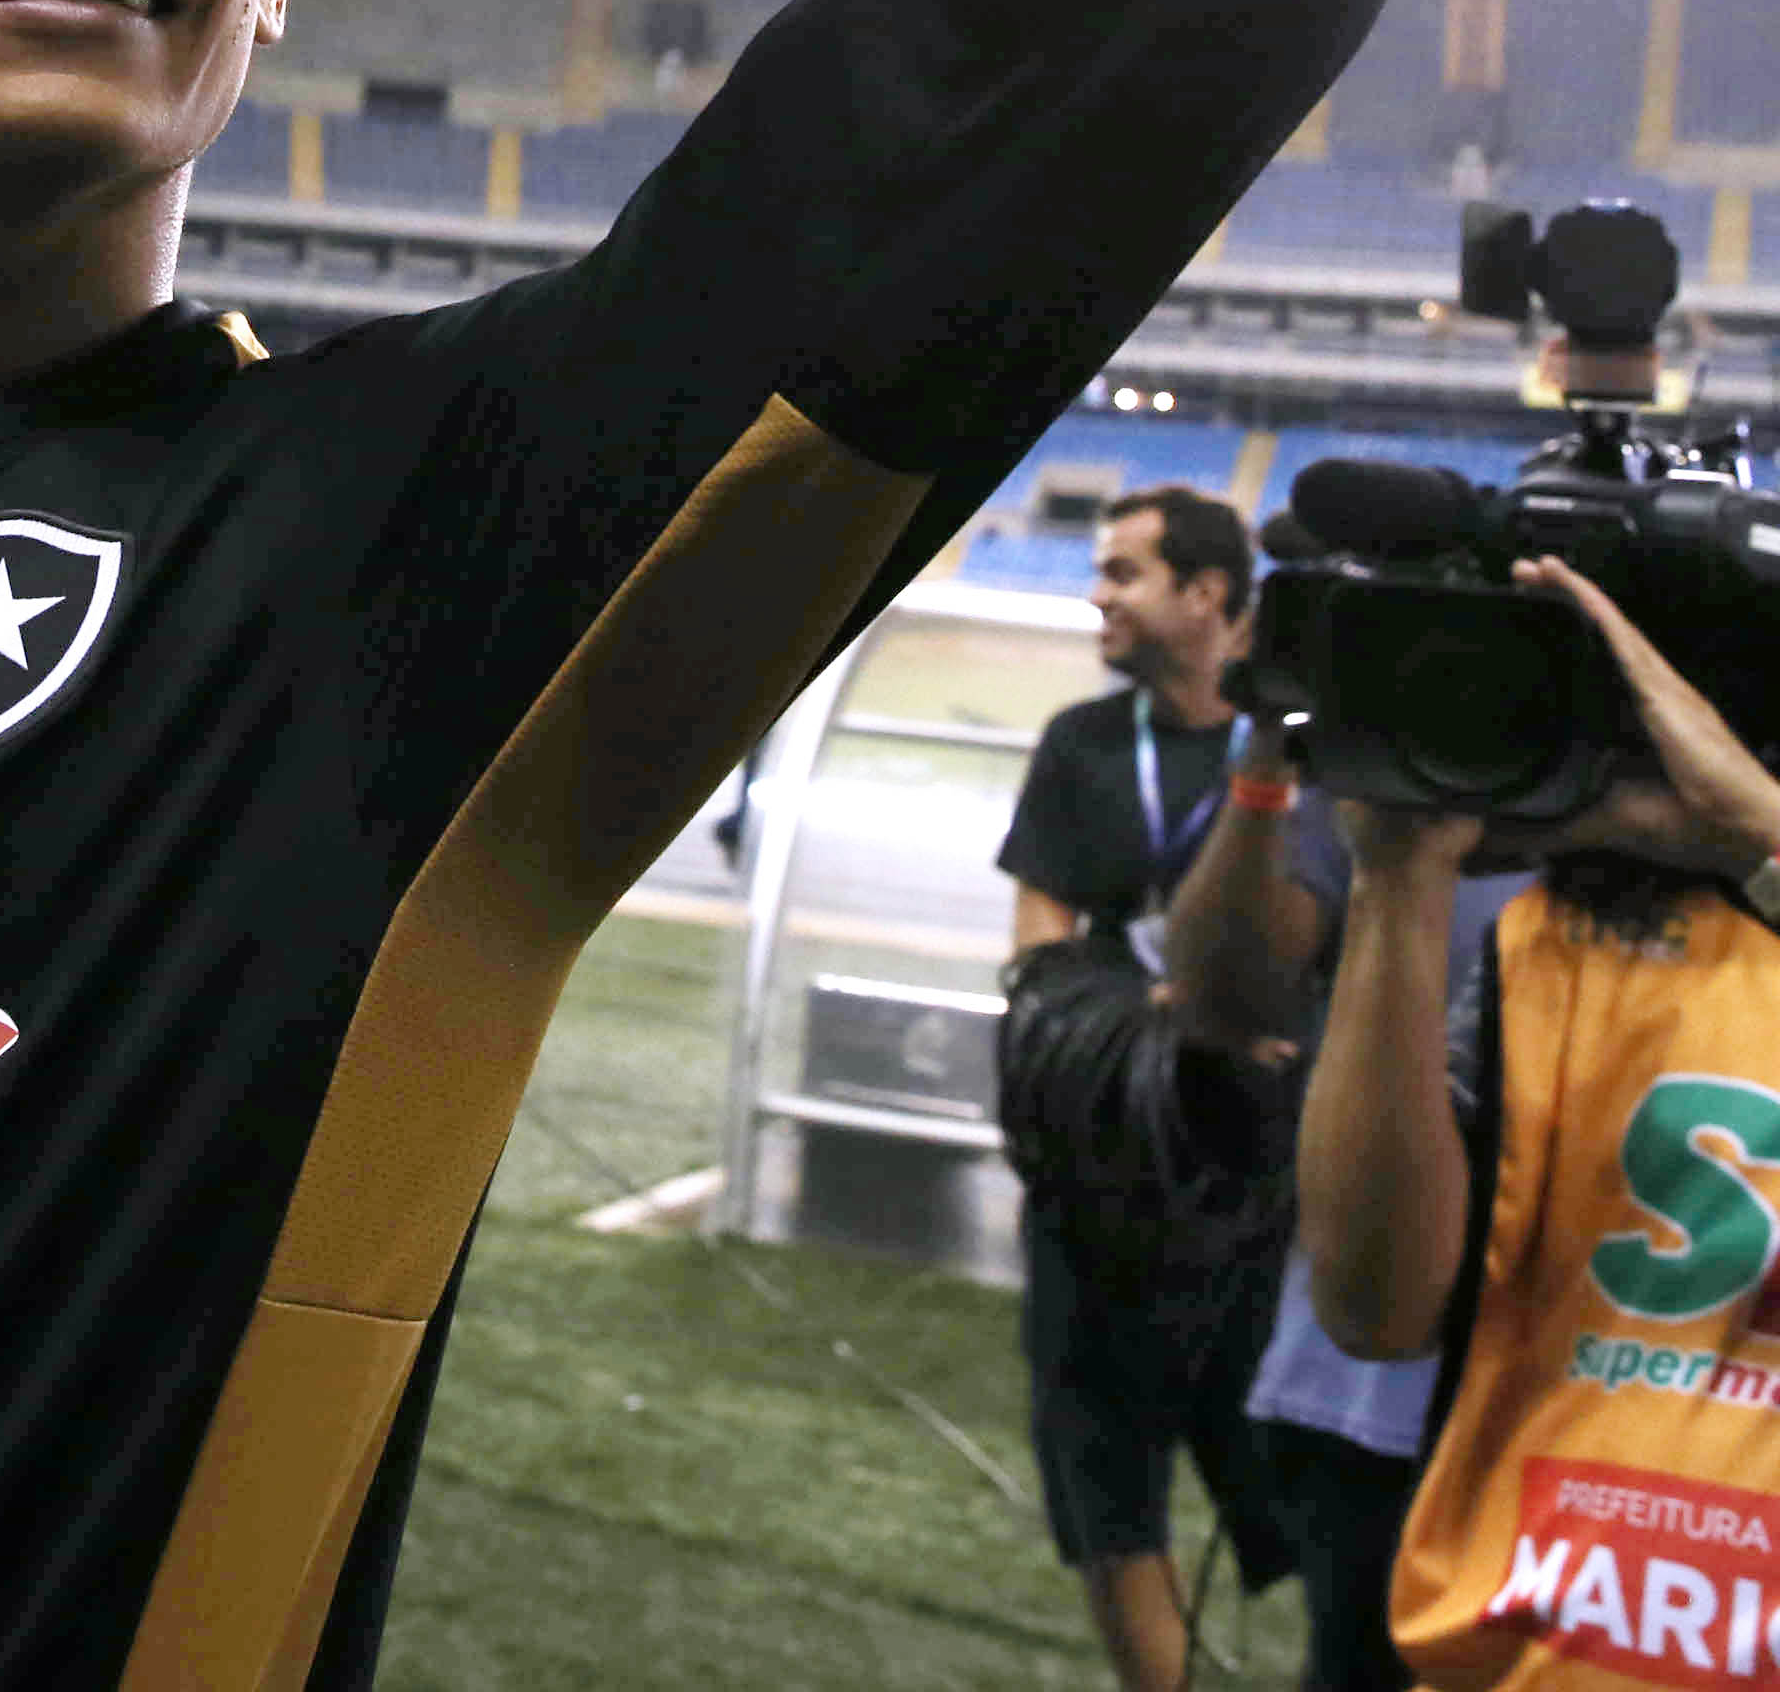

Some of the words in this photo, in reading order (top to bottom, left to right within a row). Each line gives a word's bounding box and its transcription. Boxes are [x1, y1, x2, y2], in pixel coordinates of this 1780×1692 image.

[1588, 1072, 1780, 1322] S
[1557, 1478, 1772, 1553] PREFEITURA
[1488, 1534, 1780, 1679] MARI
